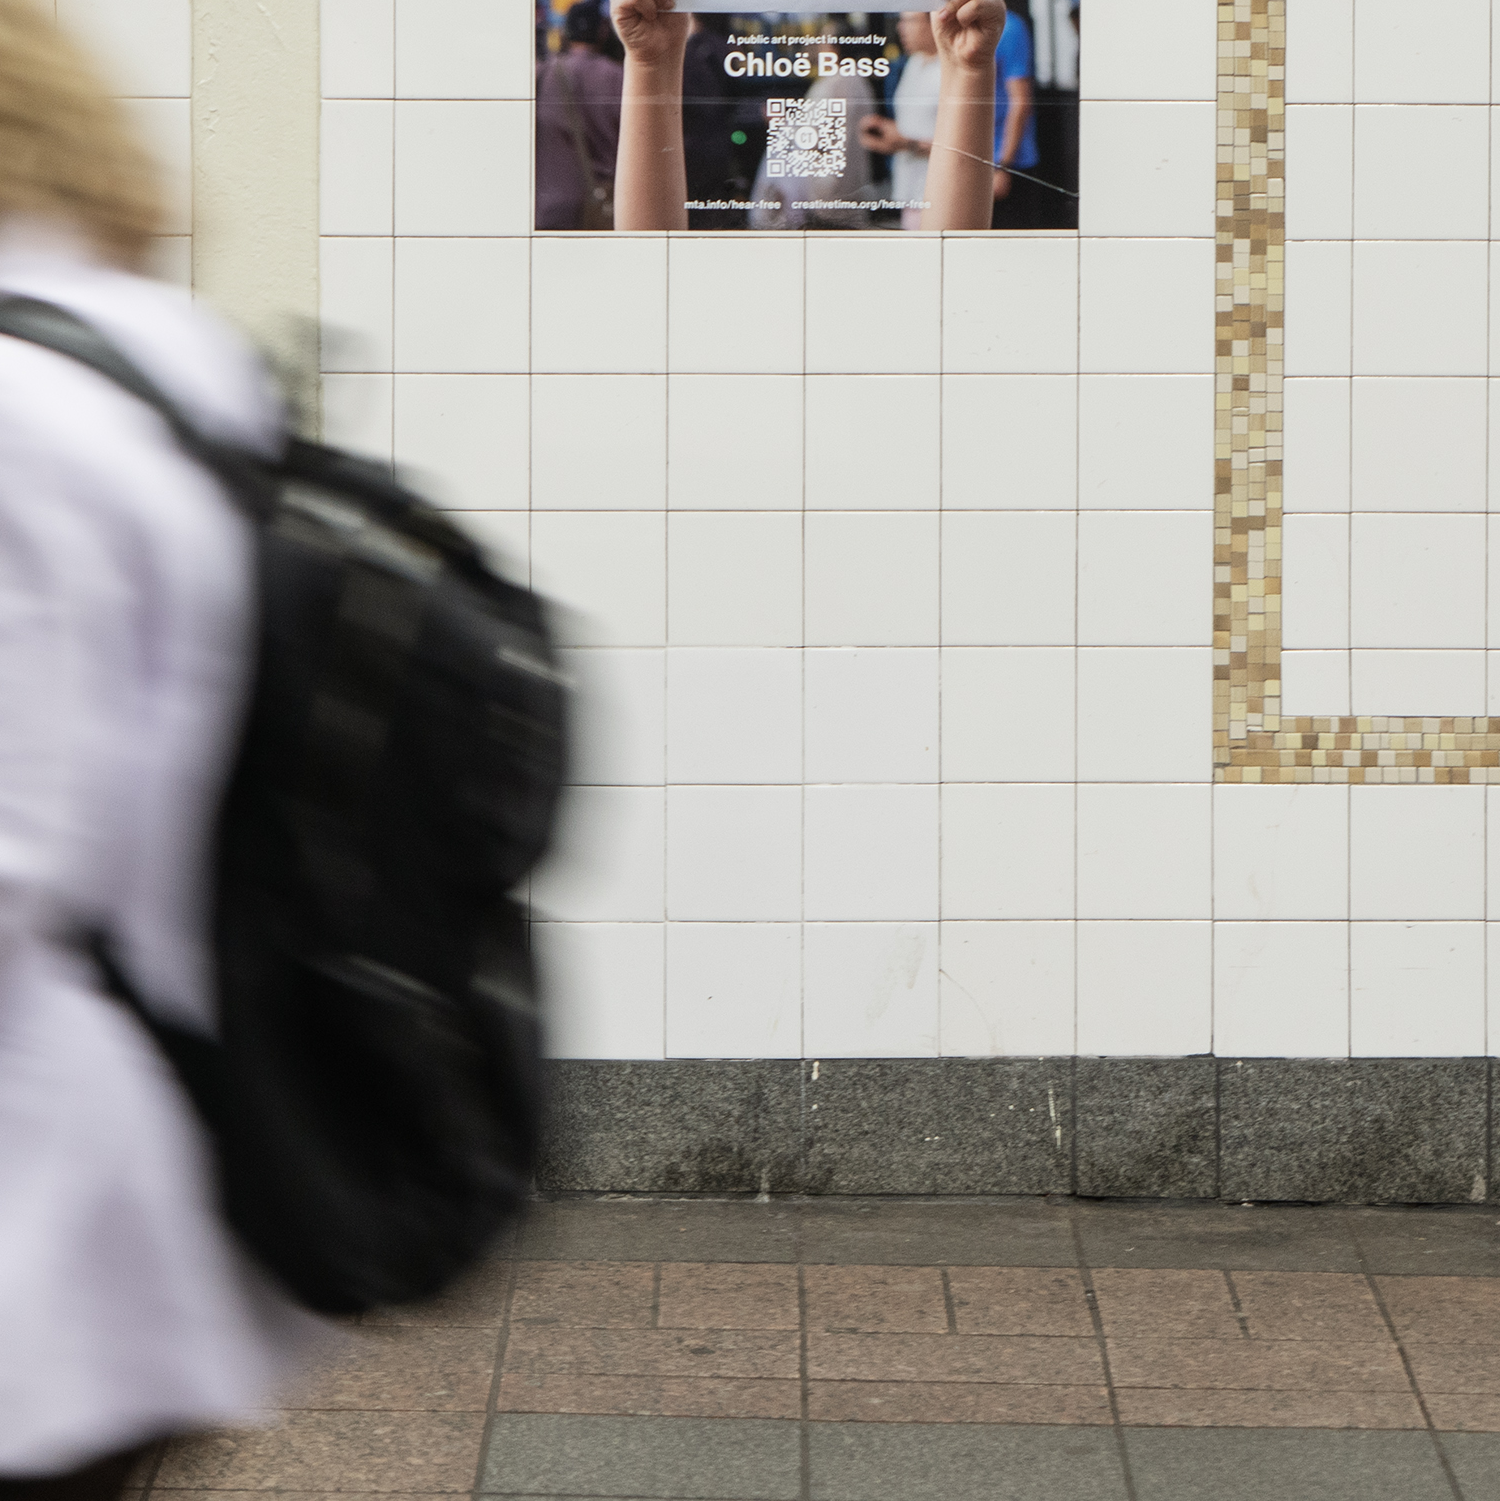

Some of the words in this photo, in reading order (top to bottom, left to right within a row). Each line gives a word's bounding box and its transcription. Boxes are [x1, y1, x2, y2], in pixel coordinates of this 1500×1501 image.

[727, 35, 737, 44] A
[737, 34, 770, 46] public
[770, 35, 787, 44] art
[787, 34, 826, 46] project
[827, 34, 837, 44] in
[838, 34, 872, 44] sound
[873, 34, 887, 46] by
[723, 51, 811, 78] Chloë
[817, 52, 891, 78] Bass
[683, 199, 782, 210] mta.info/hear-free
[791, 199, 932, 211] creativetime.org/hear-free
